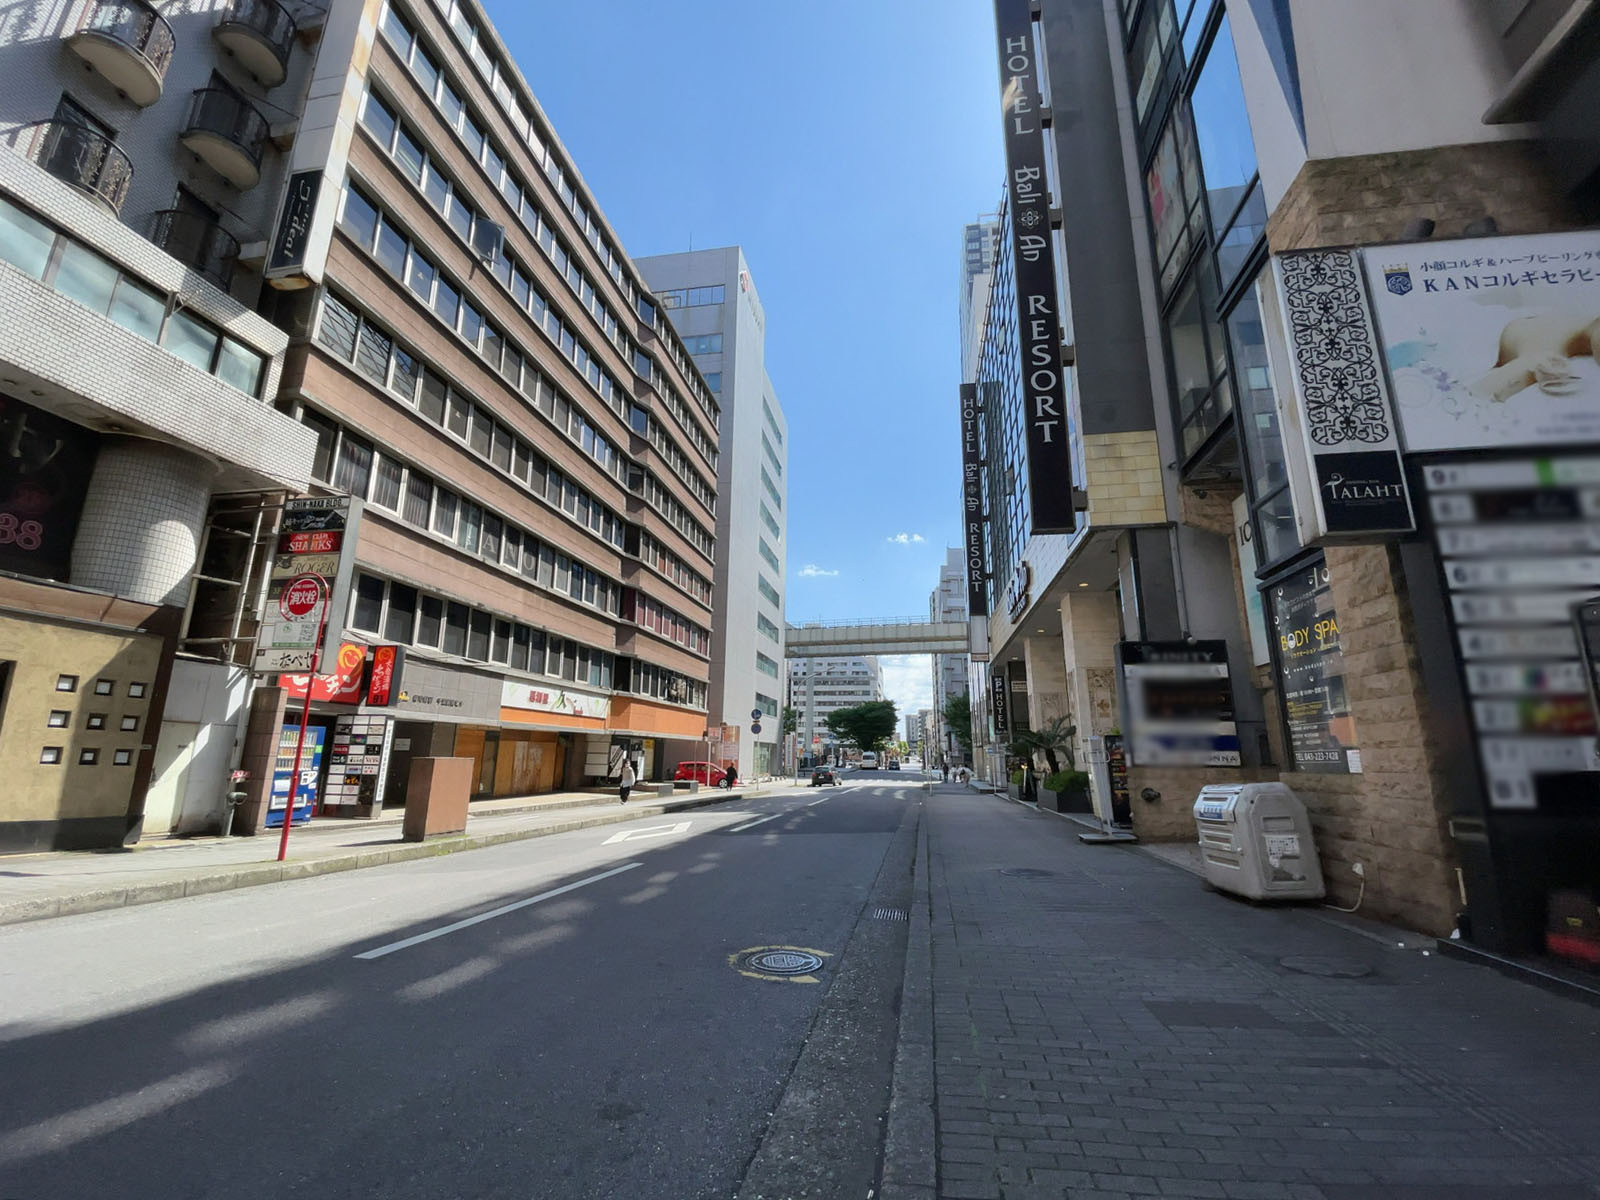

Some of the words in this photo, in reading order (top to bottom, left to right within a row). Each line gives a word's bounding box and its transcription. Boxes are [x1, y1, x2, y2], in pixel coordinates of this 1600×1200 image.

[1006, 36, 1034, 135] HOTEL
[1027, 295, 1061, 443] RESORT
[963, 399, 976, 453] HOTEL
[294, 560, 335, 574] ROGER
[969, 522, 983, 593] RESORT
[289, 590, 317, 605] 消火栓
[1280, 626, 1309, 652] BODY
[1314, 619, 1341, 640] SPA
